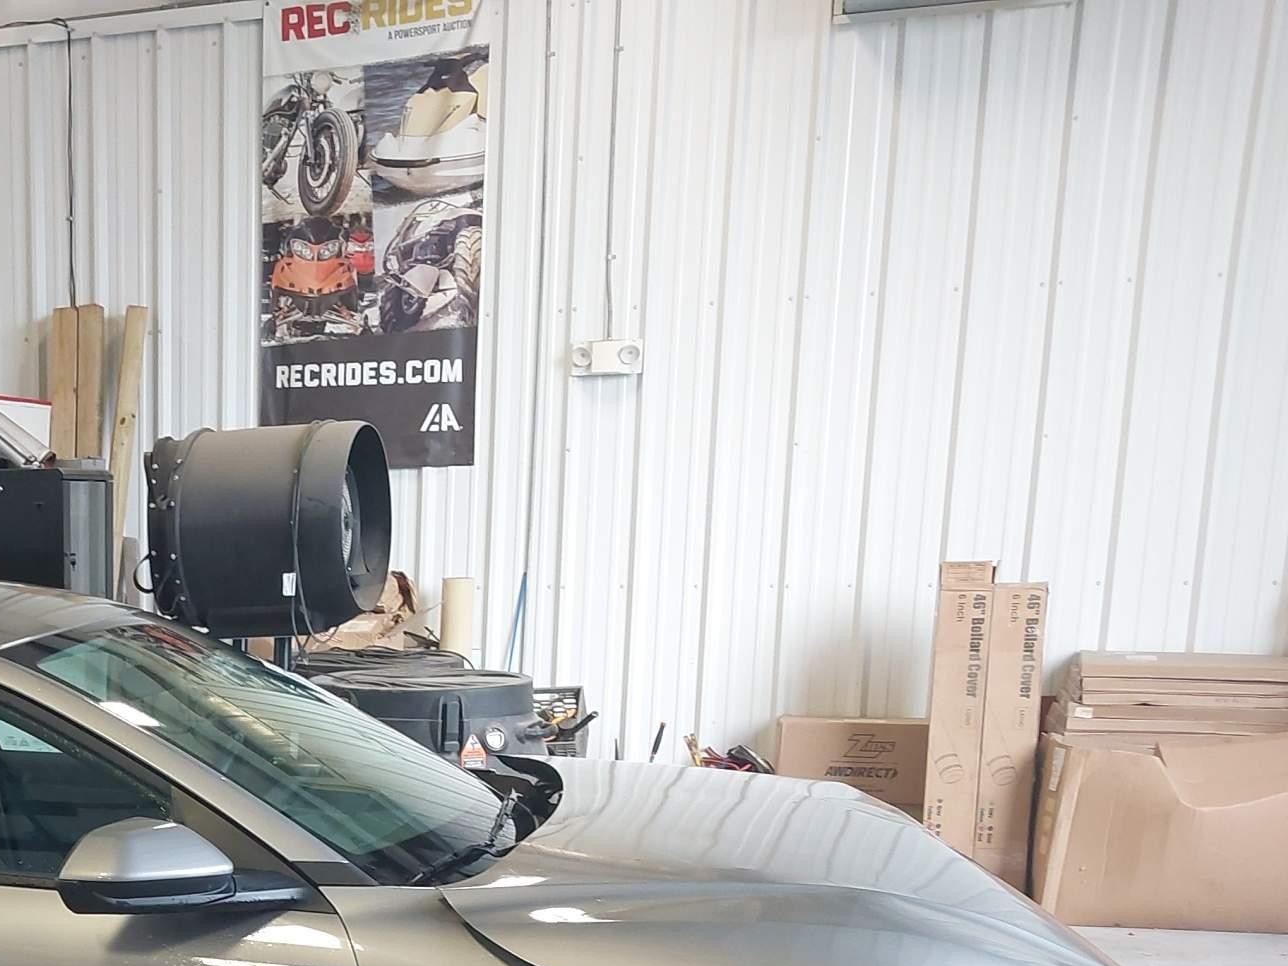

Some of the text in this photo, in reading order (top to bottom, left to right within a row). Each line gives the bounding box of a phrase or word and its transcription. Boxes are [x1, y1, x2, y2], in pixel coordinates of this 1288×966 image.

[281, 1, 351, 41] REC
[394, 23, 441, 39] POWERSPORT
[276, 359, 462, 388] RECRIDES.COM
[971, 594, 986, 615] 46"
[1026, 594, 1041, 616] 46"
[969, 617, 985, 661] Bollard
[1023, 618, 1039, 661] Bollard
[966, 664, 981, 698] Cover
[1019, 664, 1035, 699] Cover
